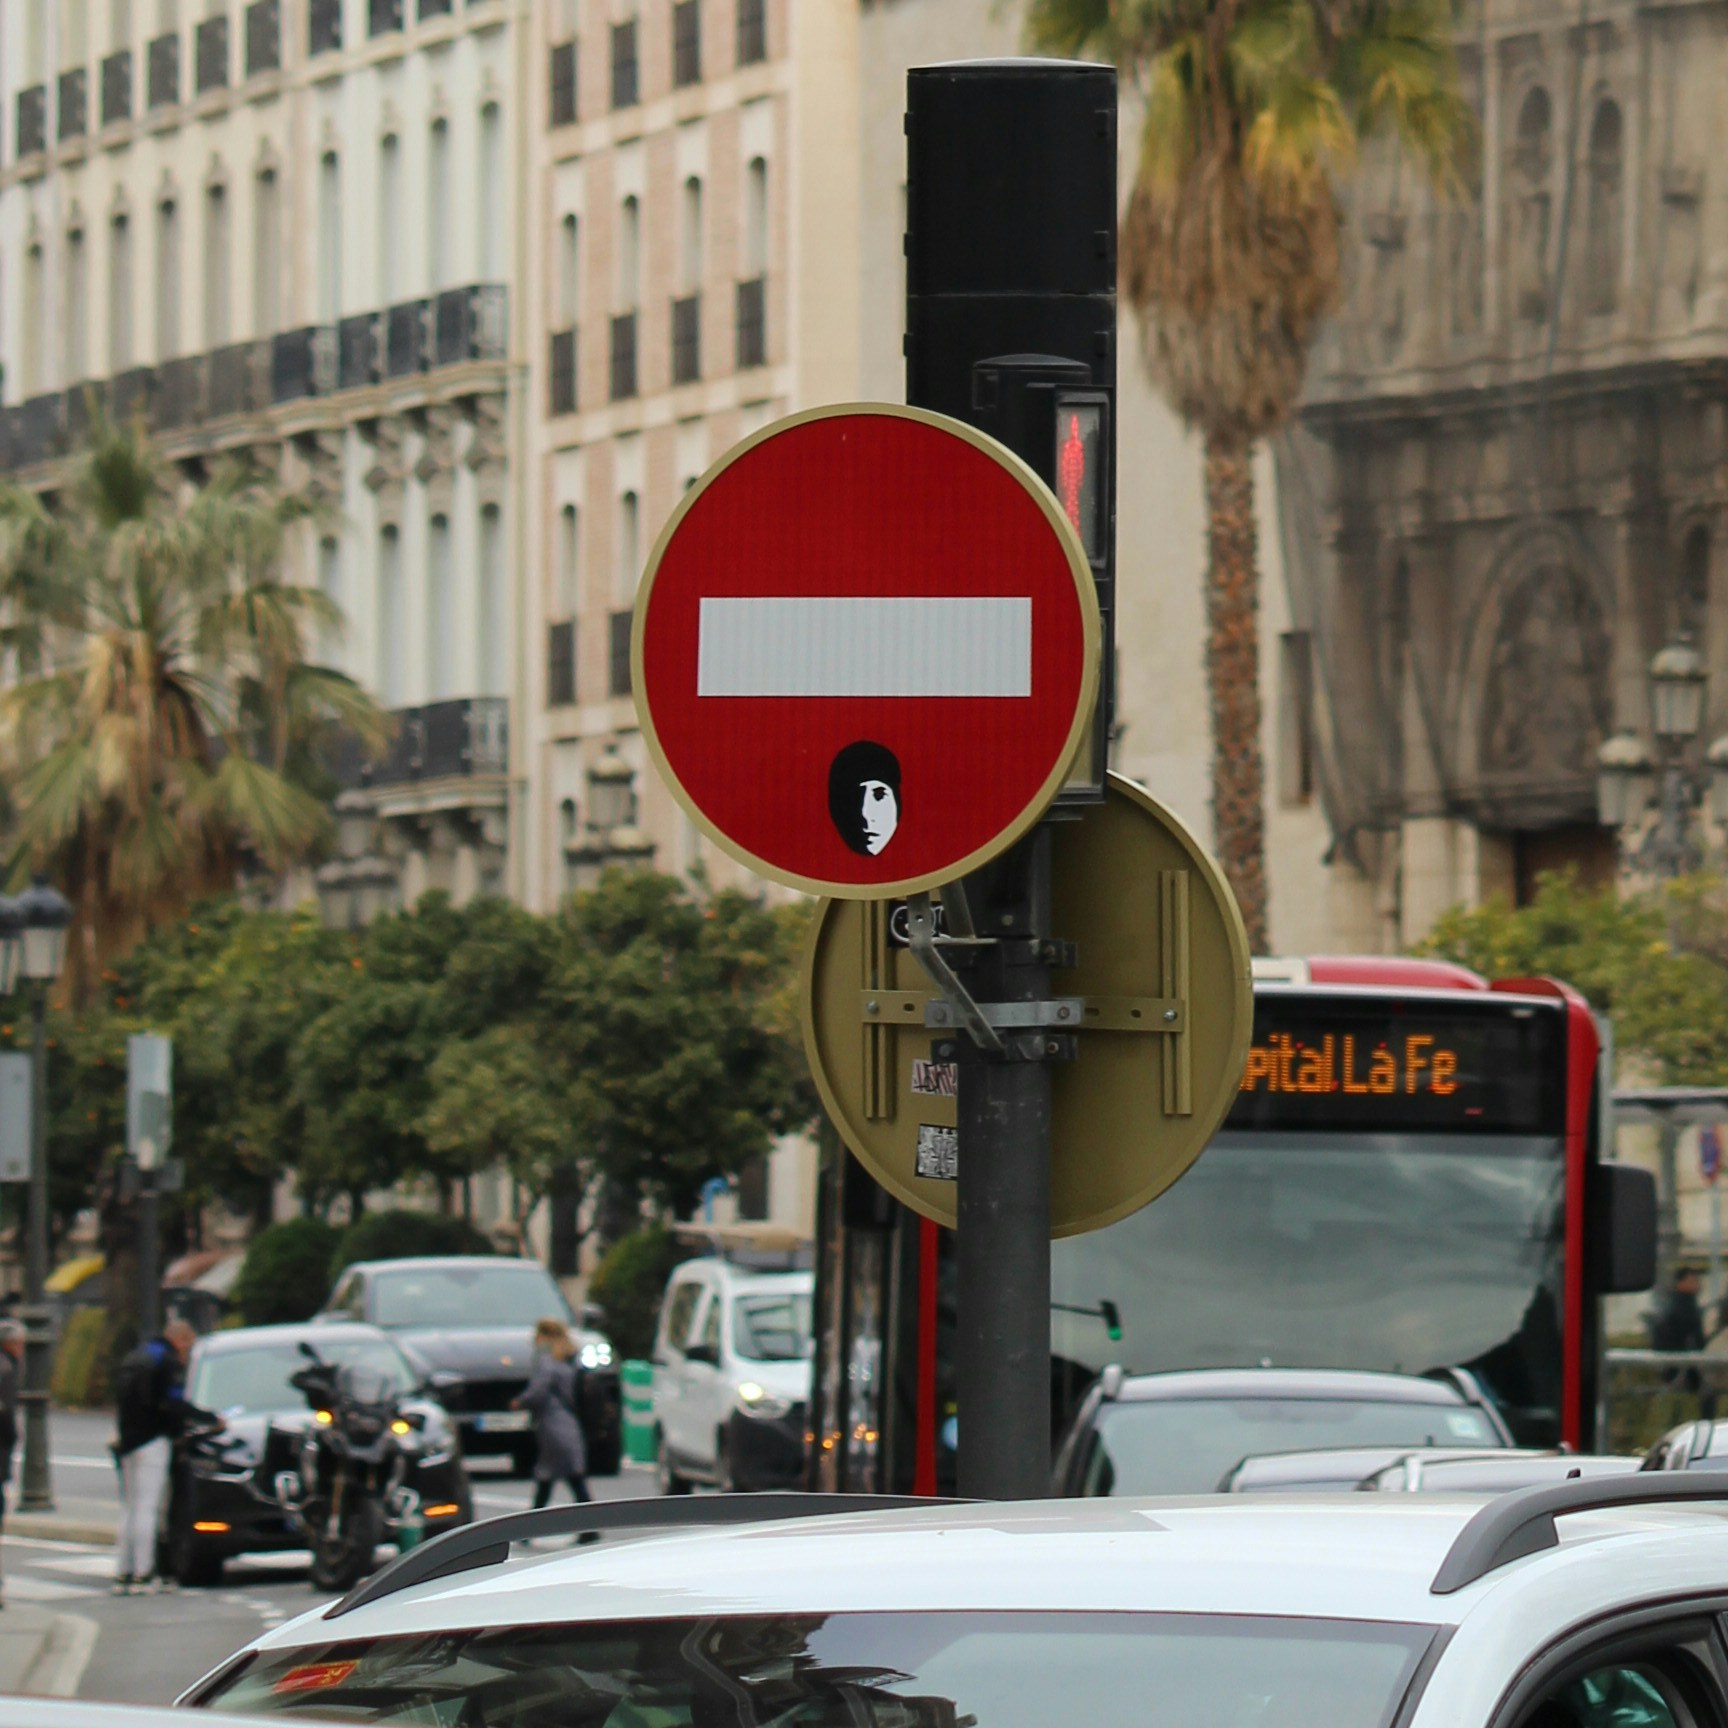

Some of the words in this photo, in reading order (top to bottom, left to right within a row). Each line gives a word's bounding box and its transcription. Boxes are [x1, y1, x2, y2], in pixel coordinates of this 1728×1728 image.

[1239, 1031, 1335, 1093] pital
[1342, 1034, 1396, 1094] La
[1405, 1034, 1458, 1095] Fe
